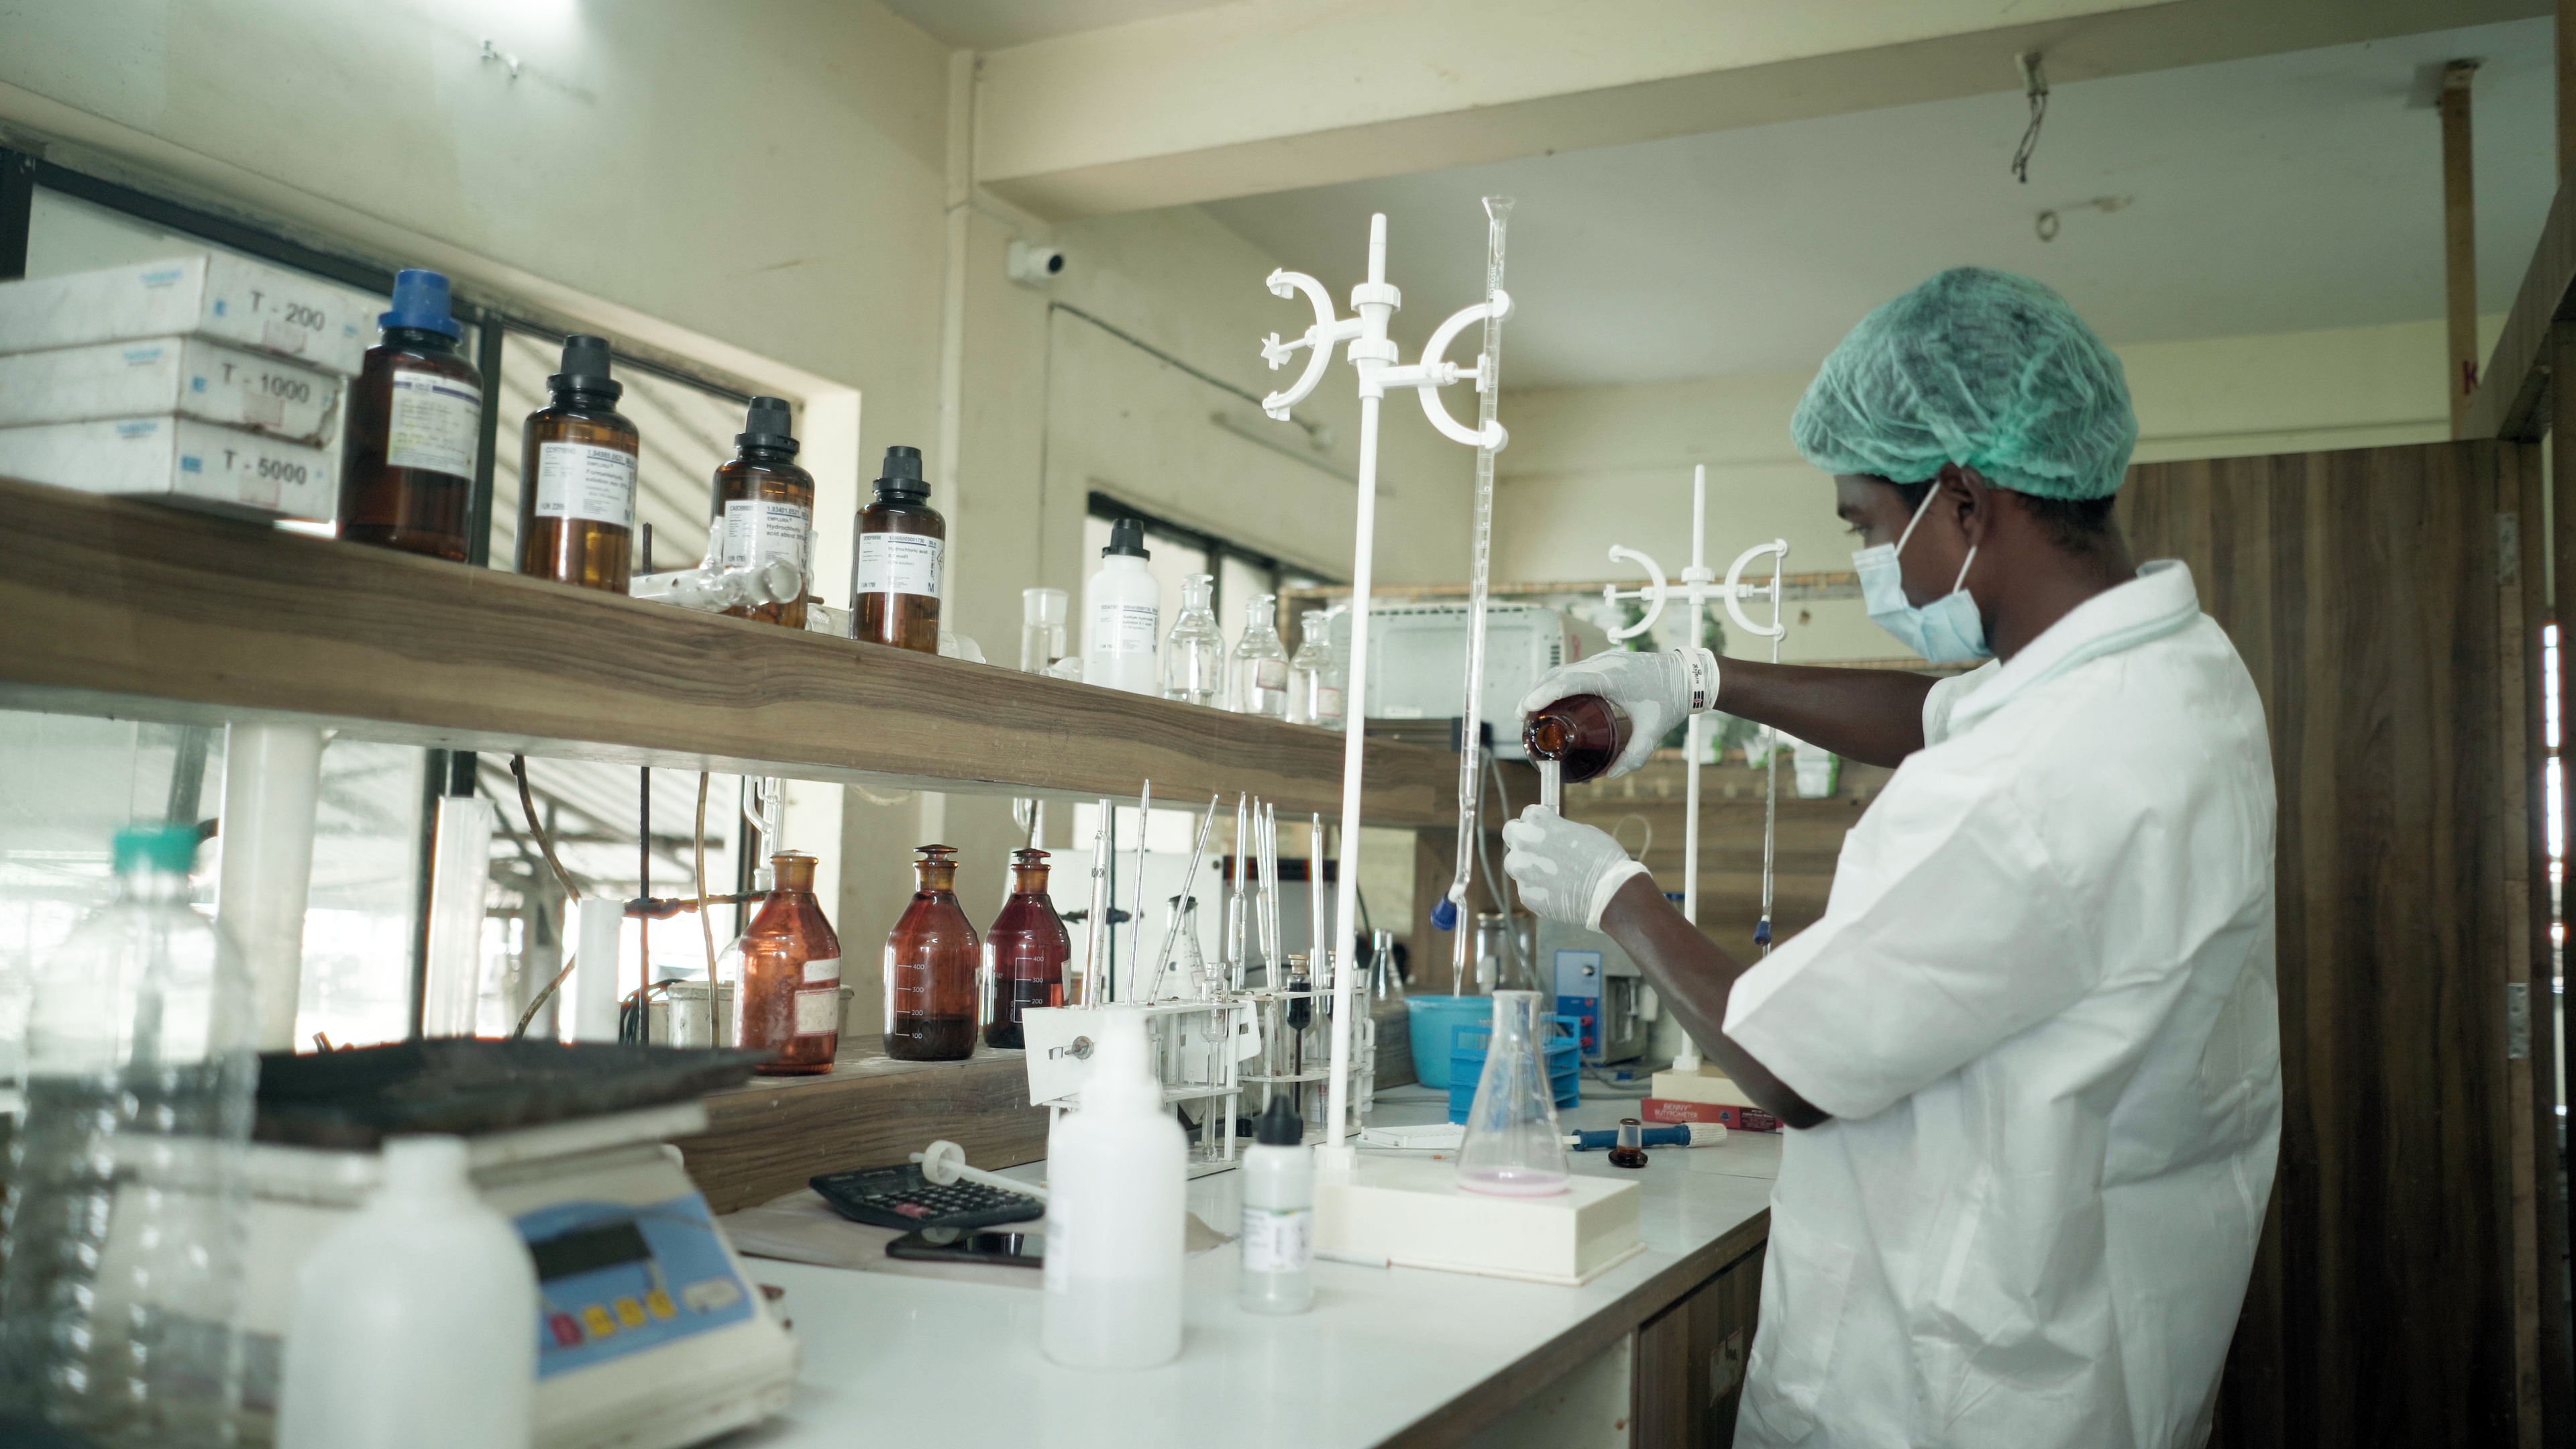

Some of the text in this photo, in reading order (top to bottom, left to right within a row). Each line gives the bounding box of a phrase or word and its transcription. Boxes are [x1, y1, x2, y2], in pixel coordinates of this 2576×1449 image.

[252, 290, 264, 313] T
[285, 302, 326, 332] 200
[222, 363, 234, 385] T
[261, 372, 311, 403] 1000
[224, 449, 237, 470] T
[258, 457, 307, 485] 5000
[767, 523, 801, 534] Hydrochloric
[928, 582, 934, 593] M
[1654, 1109, 1699, 1119] BUTYROMETER
